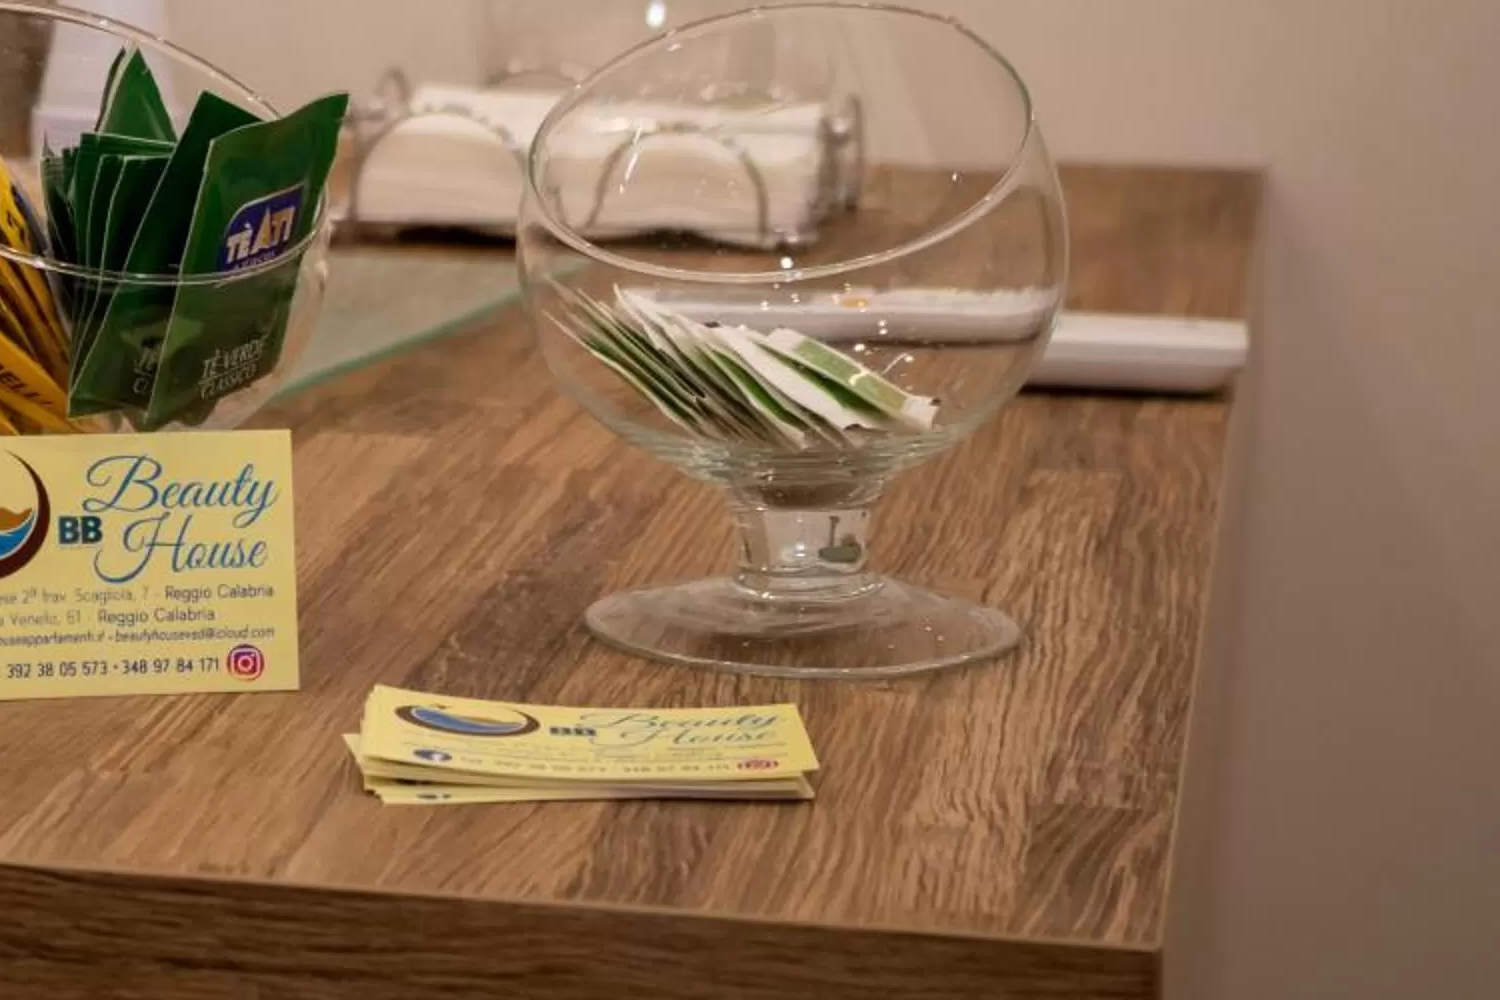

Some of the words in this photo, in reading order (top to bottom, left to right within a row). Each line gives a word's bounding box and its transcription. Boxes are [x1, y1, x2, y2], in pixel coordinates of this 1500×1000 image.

[82, 453, 280, 529] Beauty
[57, 515, 104, 545] BB
[93, 511, 270, 584] House
[164, 584, 213, 603] Reggio
[217, 583, 275, 599] Calabria
[97, 608, 149, 626] Reggio
[153, 606, 216, 622] Calabria
[6, 663, 32, 679] 392
[37, 662, 54, 677] 38
[59, 661, 77, 677] 05
[82, 660, 108, 676] 573
[121, 659, 148, 675] 348
[152, 658, 170, 674] 97
[176, 658, 194, 673] 84
[199, 656, 220, 672] 171
